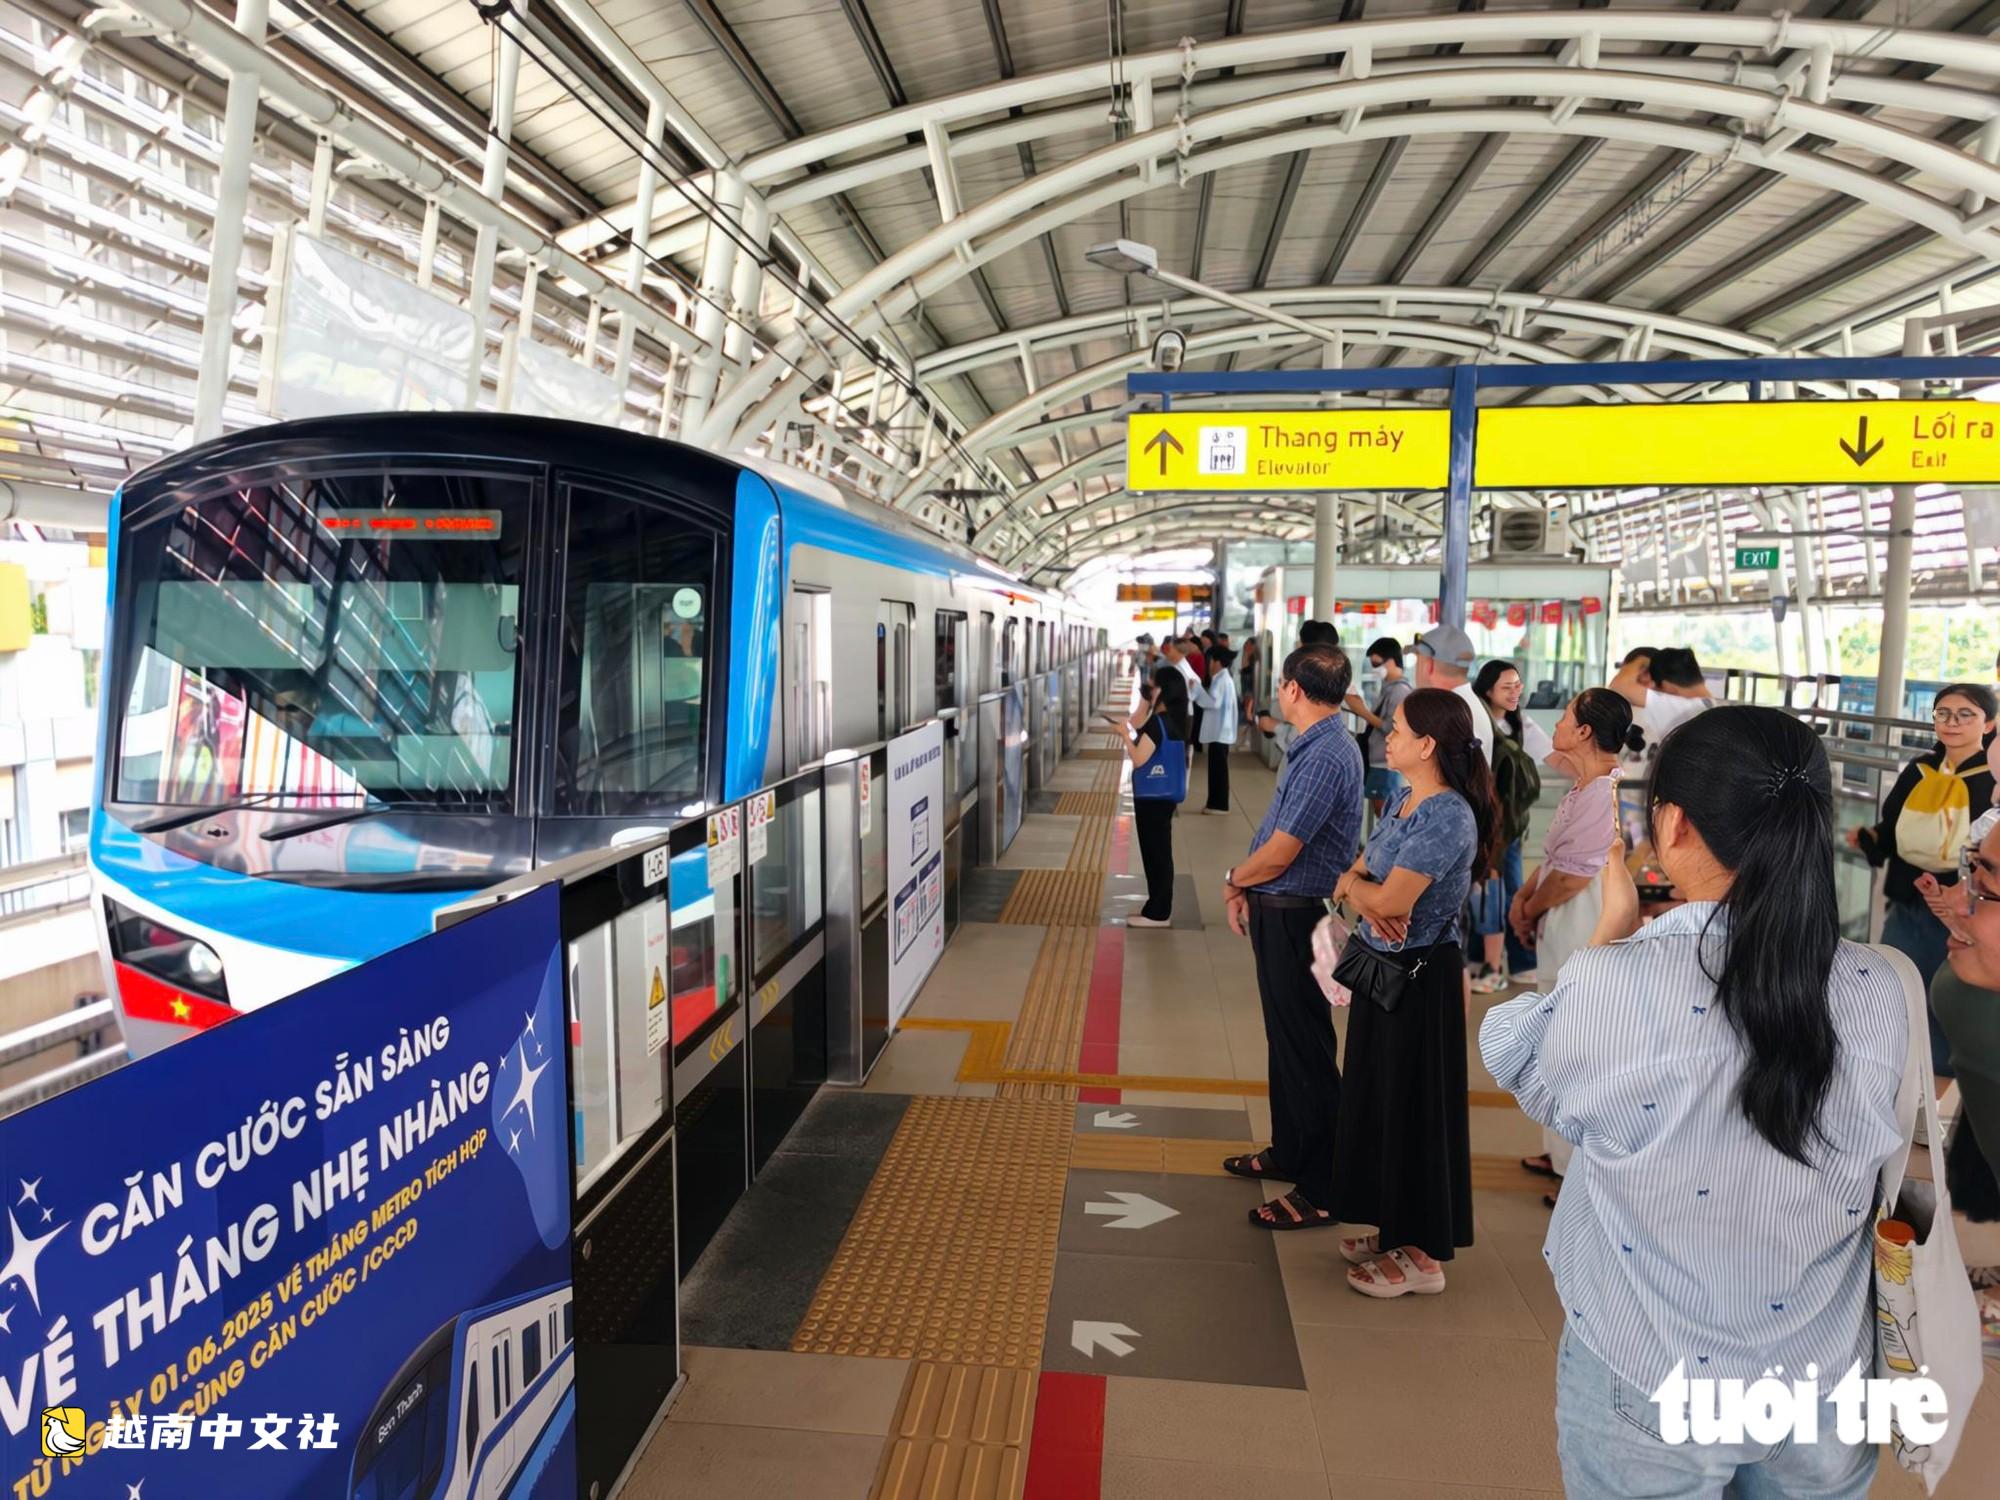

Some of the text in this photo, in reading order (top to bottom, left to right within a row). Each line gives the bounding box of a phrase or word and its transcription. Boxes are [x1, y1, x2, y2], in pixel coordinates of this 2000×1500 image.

[1257, 459, 1332, 476] Elevator
[1260, 424, 1404, 453] Thang máy
[1913, 411, 1994, 439] Lối ra
[1743, 551, 1771, 567] EXIT
[81, 1015, 450, 1256] CĂN CƯỚC SẴN SÀNG
[0, 1061, 490, 1436] VÉ THÁNG NHẸ NHÀNG
[150, 1291, 273, 1405] 01.06.2025
[277, 1263, 302, 1303] VÉ
[305, 1219, 369, 1283] THÁNG
[372, 1178, 423, 1232] METRO
[424, 1150, 458, 1190] TÍCH
[459, 1128, 488, 1160] HỢP
[176, 1359, 246, 1422] CÙNG
[250, 1314, 297, 1370] CĂN
[300, 1267, 357, 1327] CƯỚC
